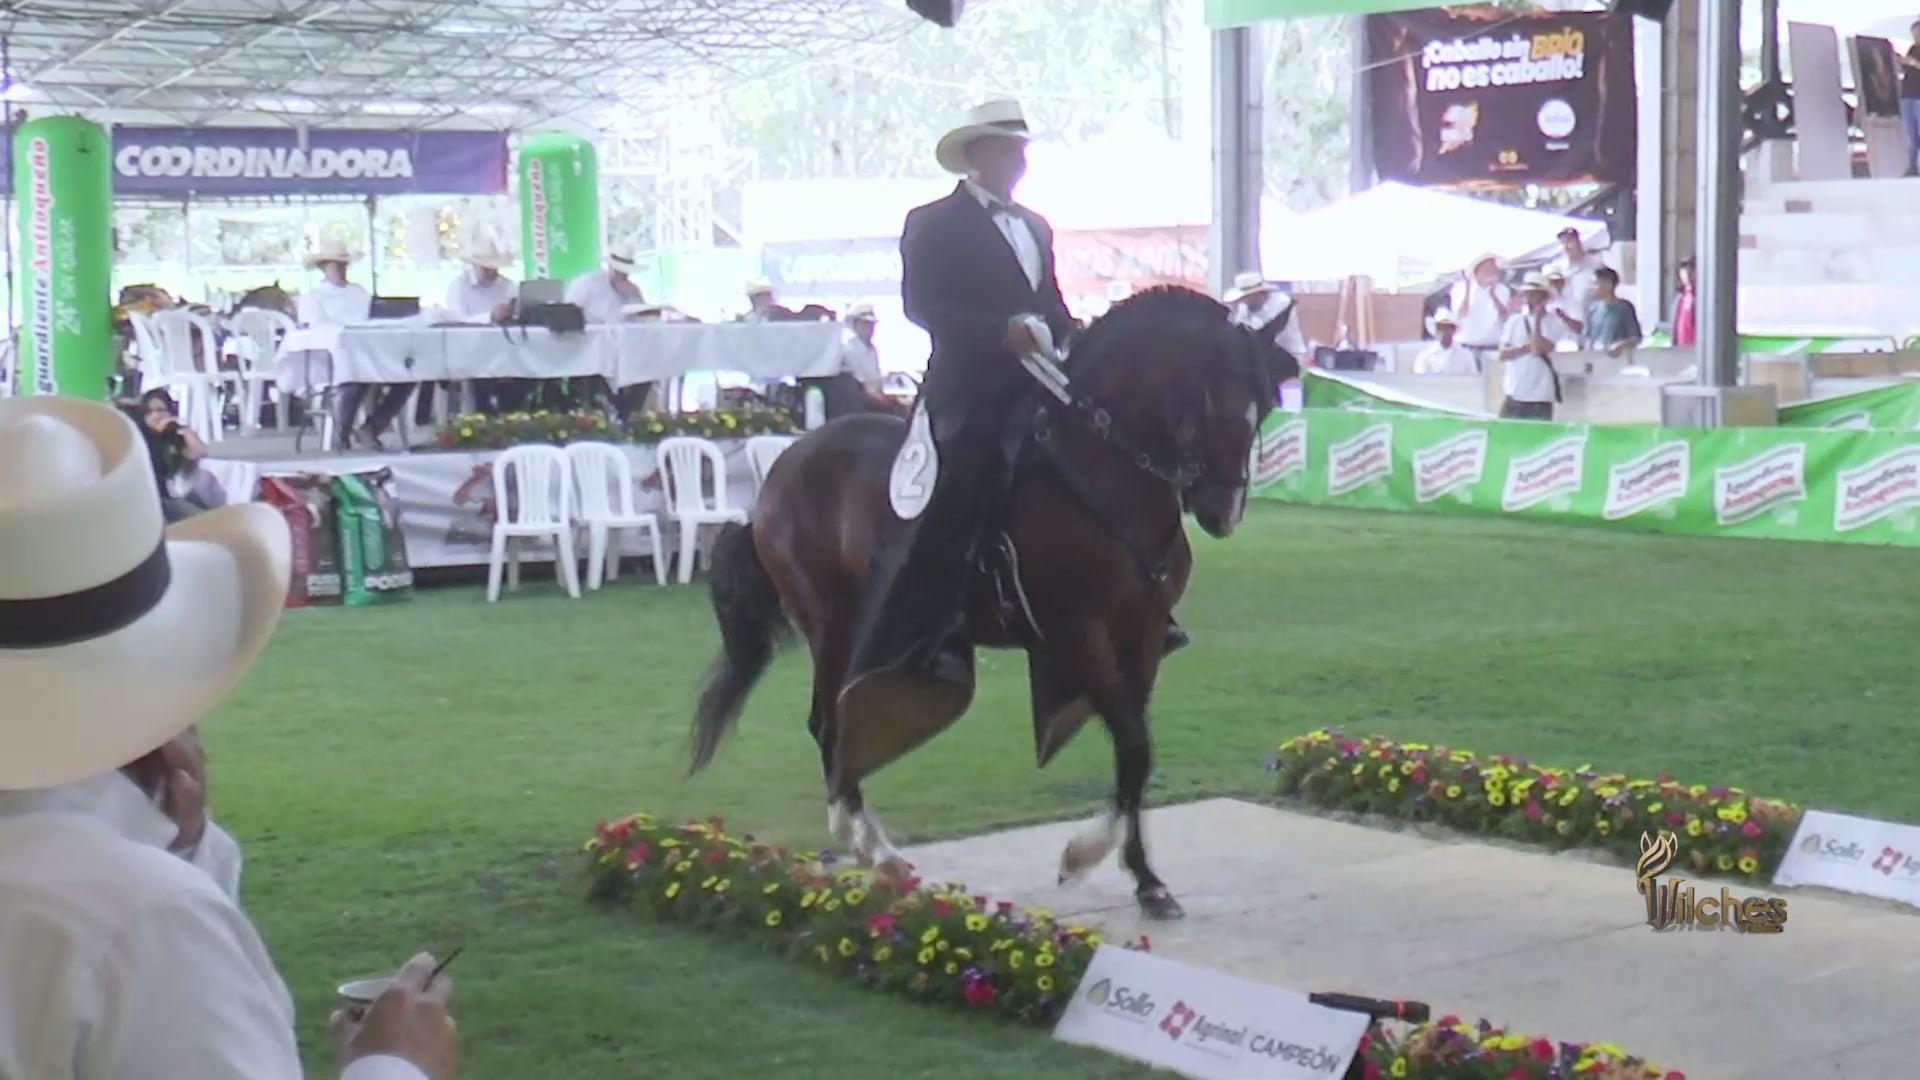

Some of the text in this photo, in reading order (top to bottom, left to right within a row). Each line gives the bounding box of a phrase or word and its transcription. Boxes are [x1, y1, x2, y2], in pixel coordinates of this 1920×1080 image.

[1502, 33, 1531, 59] sin
[1426, 53, 1584, 91] no es caballo!
[115, 145, 413, 178] COORDINADORA
[33, 278, 53, 394] guardiente
[901, 442, 928, 498] 2
